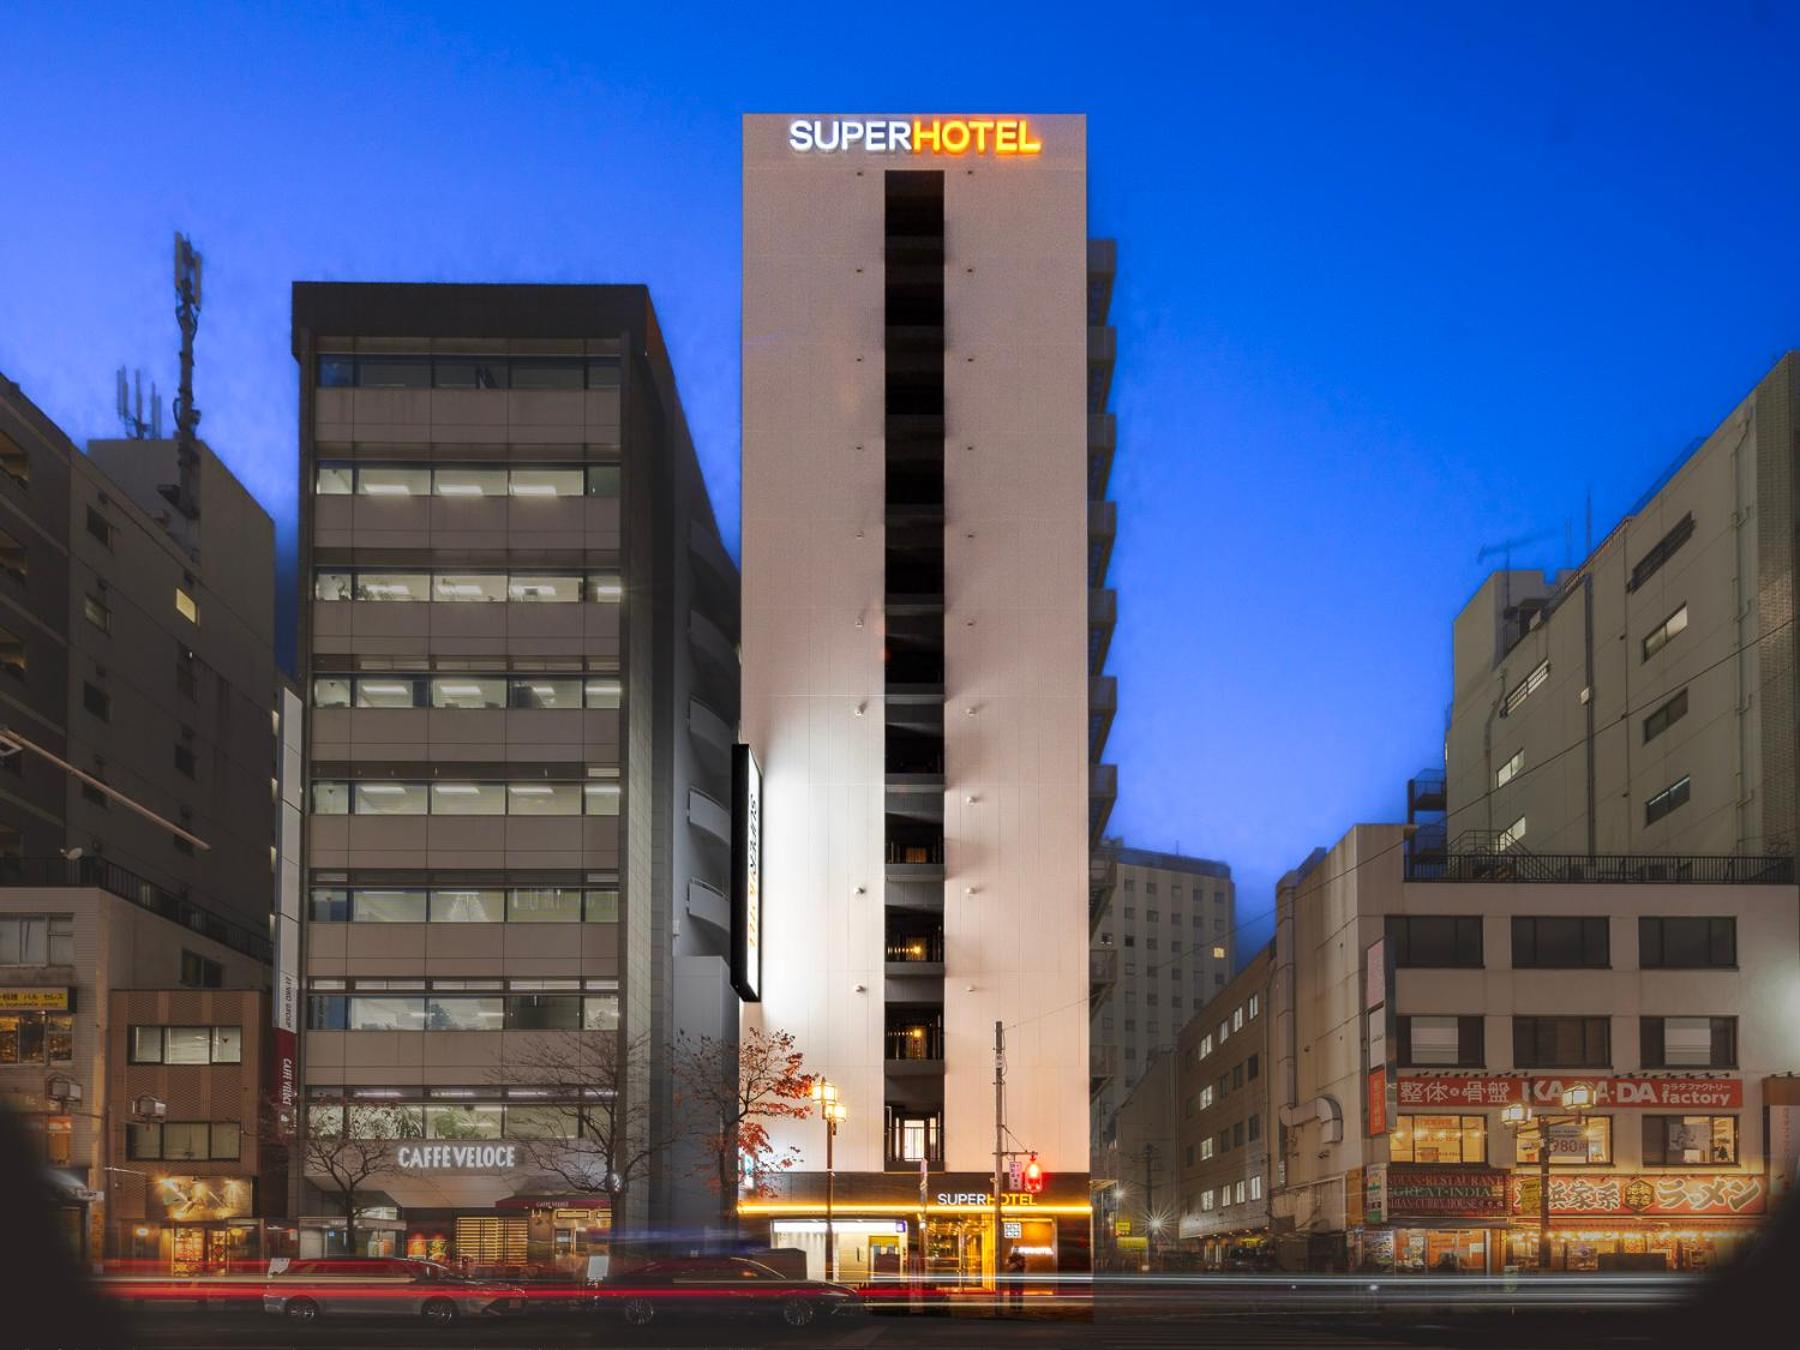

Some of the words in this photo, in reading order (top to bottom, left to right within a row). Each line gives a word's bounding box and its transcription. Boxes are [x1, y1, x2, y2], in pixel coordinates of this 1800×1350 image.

[789, 119, 1042, 153] SUPERHOTEL
[1662, 1090, 1730, 1106] factory
[453, 1146, 515, 1168] VELOCE
